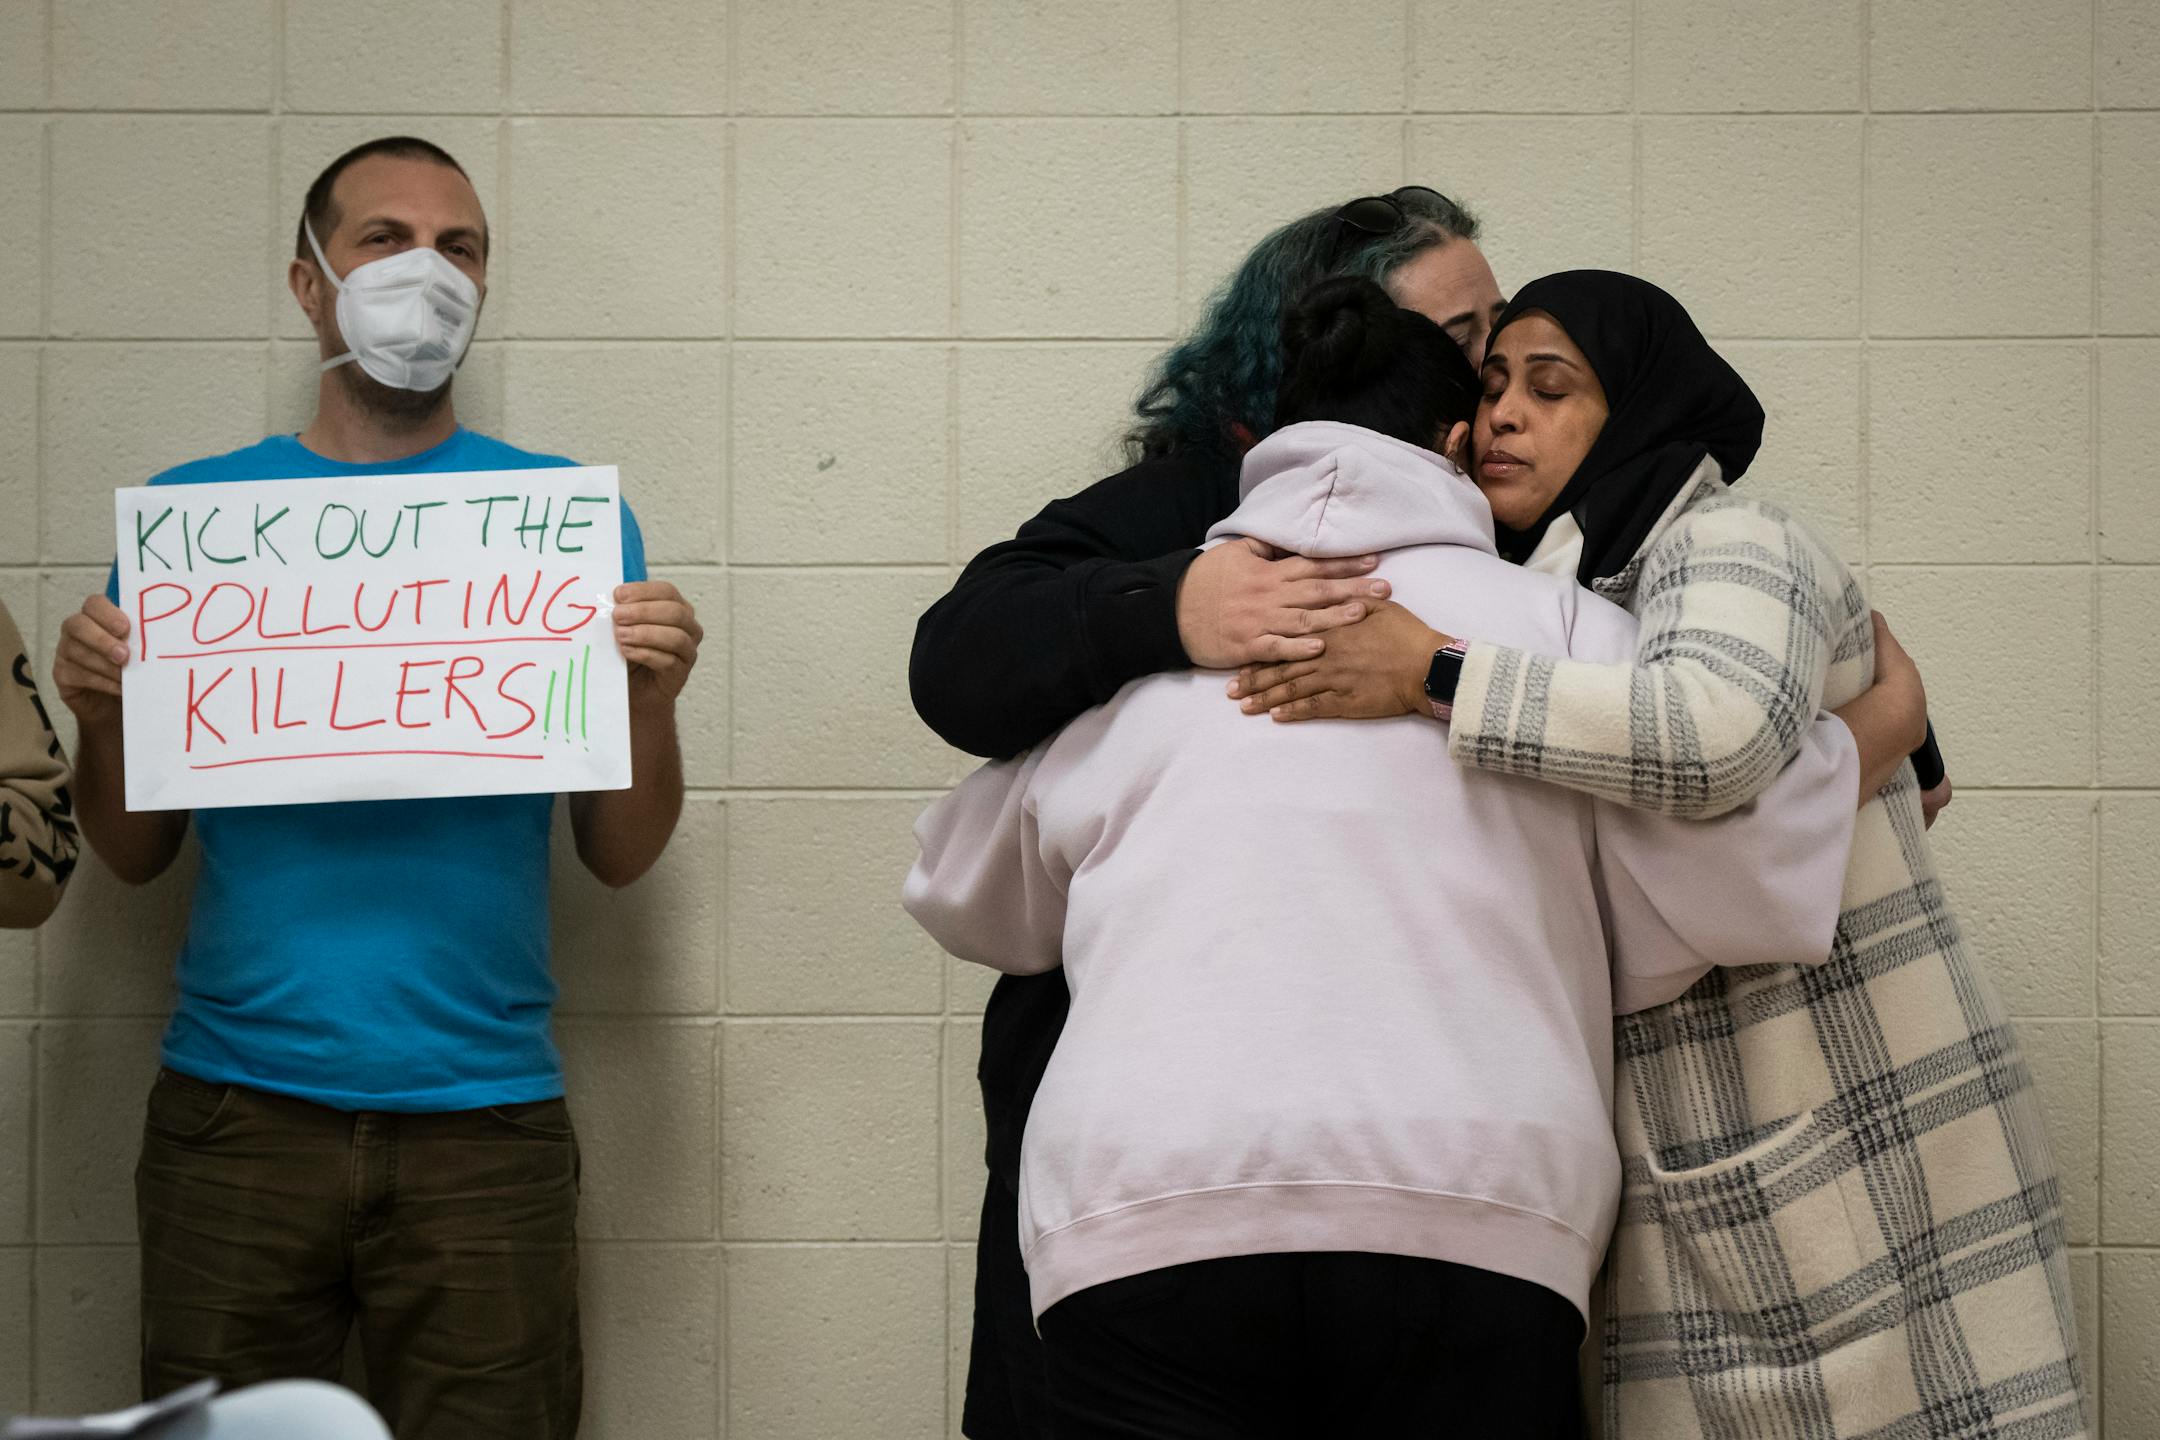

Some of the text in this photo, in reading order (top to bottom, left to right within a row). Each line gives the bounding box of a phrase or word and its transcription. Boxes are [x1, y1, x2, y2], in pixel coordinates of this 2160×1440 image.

[136, 495, 610, 572] KICK OUT THE
[138, 570, 597, 661] POLLUTING
